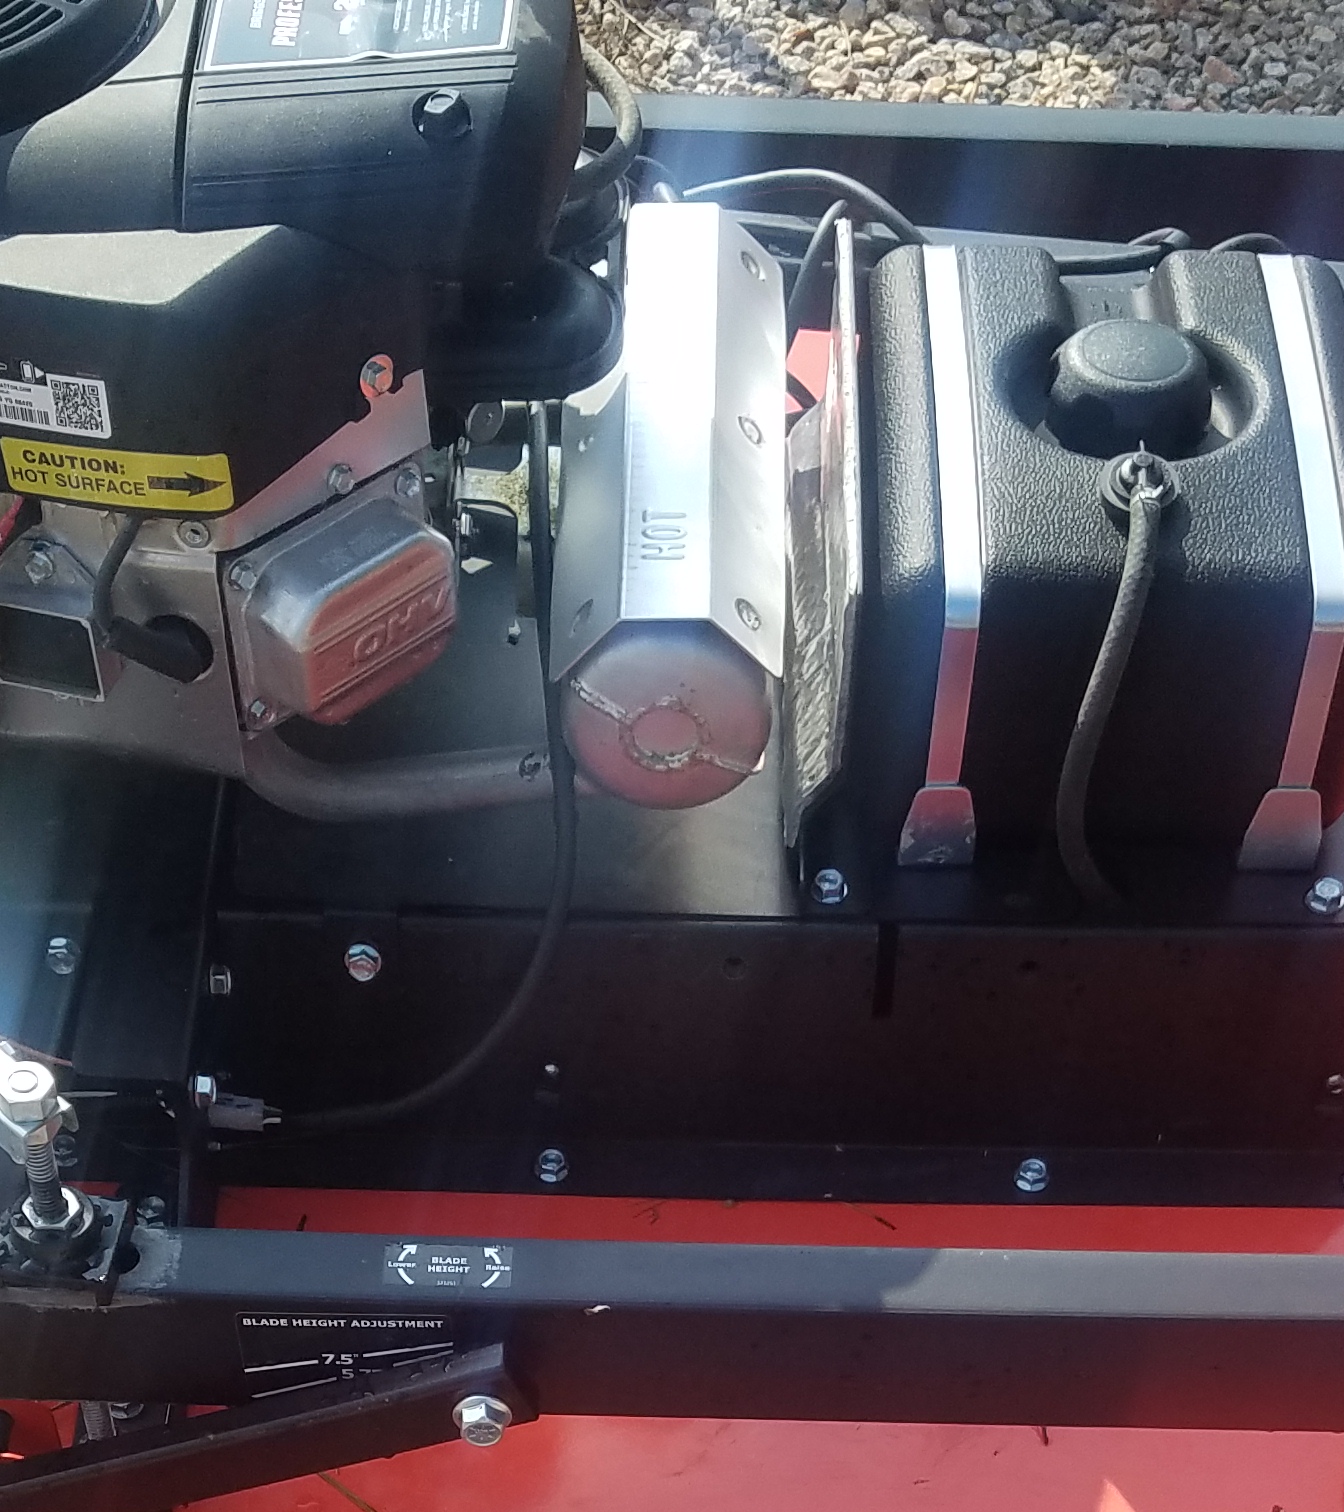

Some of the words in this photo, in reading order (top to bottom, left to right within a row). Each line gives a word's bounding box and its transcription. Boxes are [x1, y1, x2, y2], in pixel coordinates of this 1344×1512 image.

[271, 0, 306, 47] PROFE
[22, 450, 126, 475] CAUTION:
[11, 466, 49, 485] HOT
[54, 473, 146, 496] SURFACE
[641, 507, 688, 560] HOT
[427, 1265, 471, 1274] HEIGHT
[431, 1256, 468, 1265] BLADE
[242, 1318, 288, 1327] BLADE
[292, 1318, 348, 1328] HEIGHT
[350, 1319, 444, 1329] ADJUSTMENT
